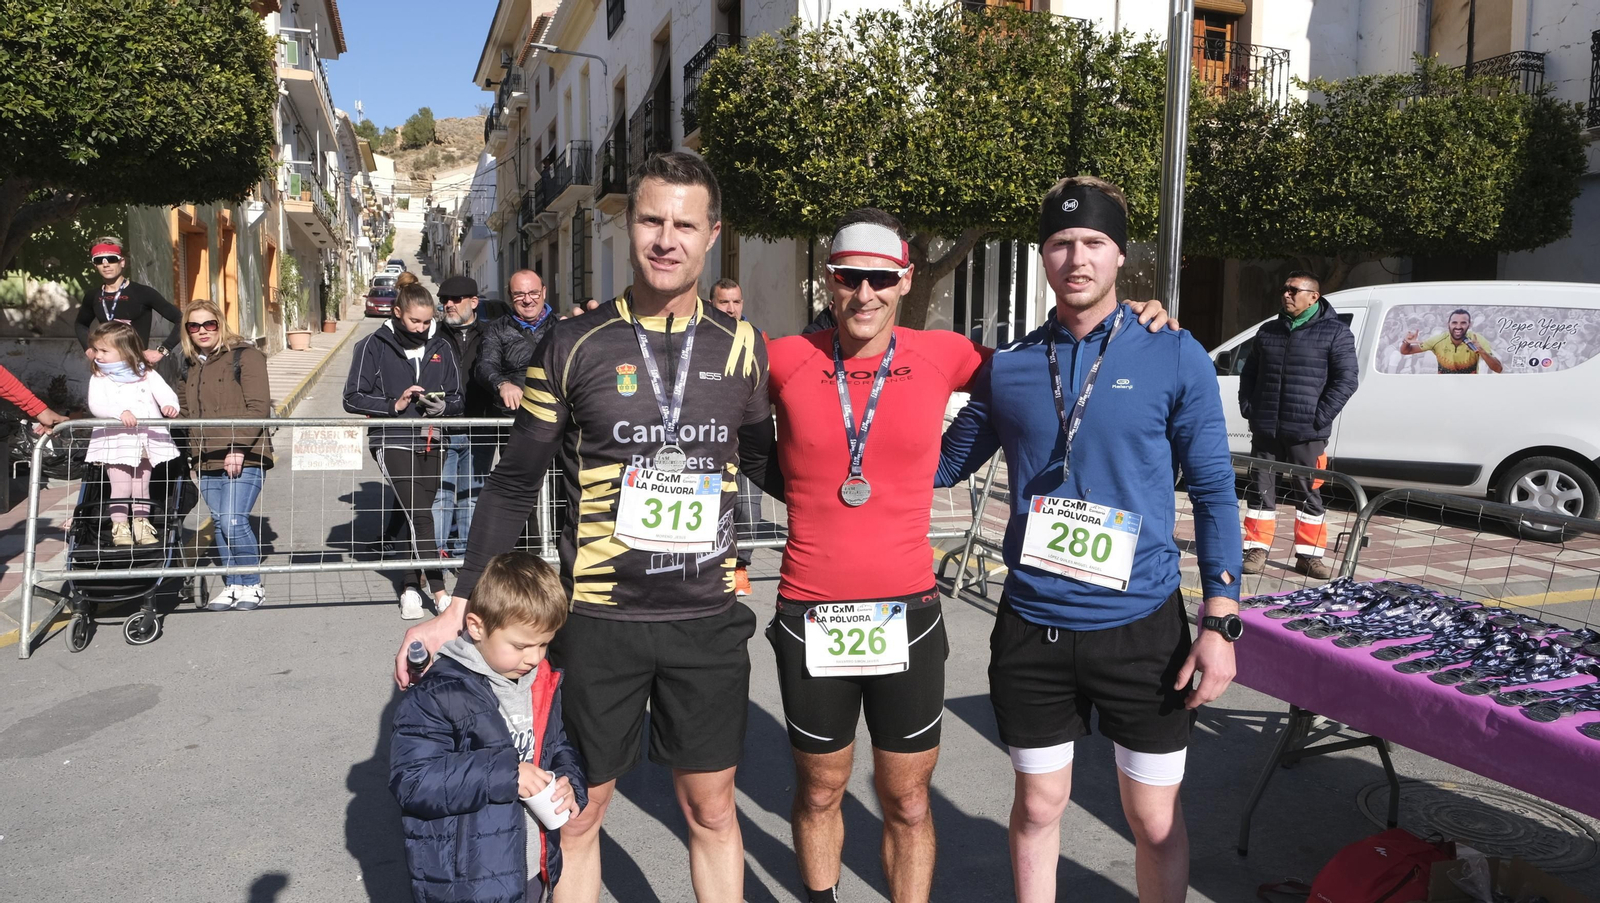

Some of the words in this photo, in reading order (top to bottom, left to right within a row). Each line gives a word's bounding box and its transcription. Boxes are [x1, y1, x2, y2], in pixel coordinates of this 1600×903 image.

[1498, 317, 1533, 337] Pepe
[1537, 318, 1578, 337] Yepes
[1507, 336, 1566, 354] Speaker
[612, 418, 728, 443] Canoria
[631, 454, 715, 470] Ruers
[641, 469, 653, 479] IV
[656, 472, 681, 483] CxM
[636, 481, 647, 490] LA
[651, 483, 694, 495] PÓLVORA
[1048, 498, 1059, 506] IV
[1062, 499, 1087, 511] CxM
[641, 497, 703, 531] 313
[1042, 507, 1054, 515] LA
[1057, 509, 1101, 526] PÓLVORA
[1047, 522, 1112, 563] 280
[819, 605, 828, 613] IV
[832, 605, 854, 613] CxM
[830, 614, 871, 623] PÓLVORA
[827, 627, 886, 656] 326
